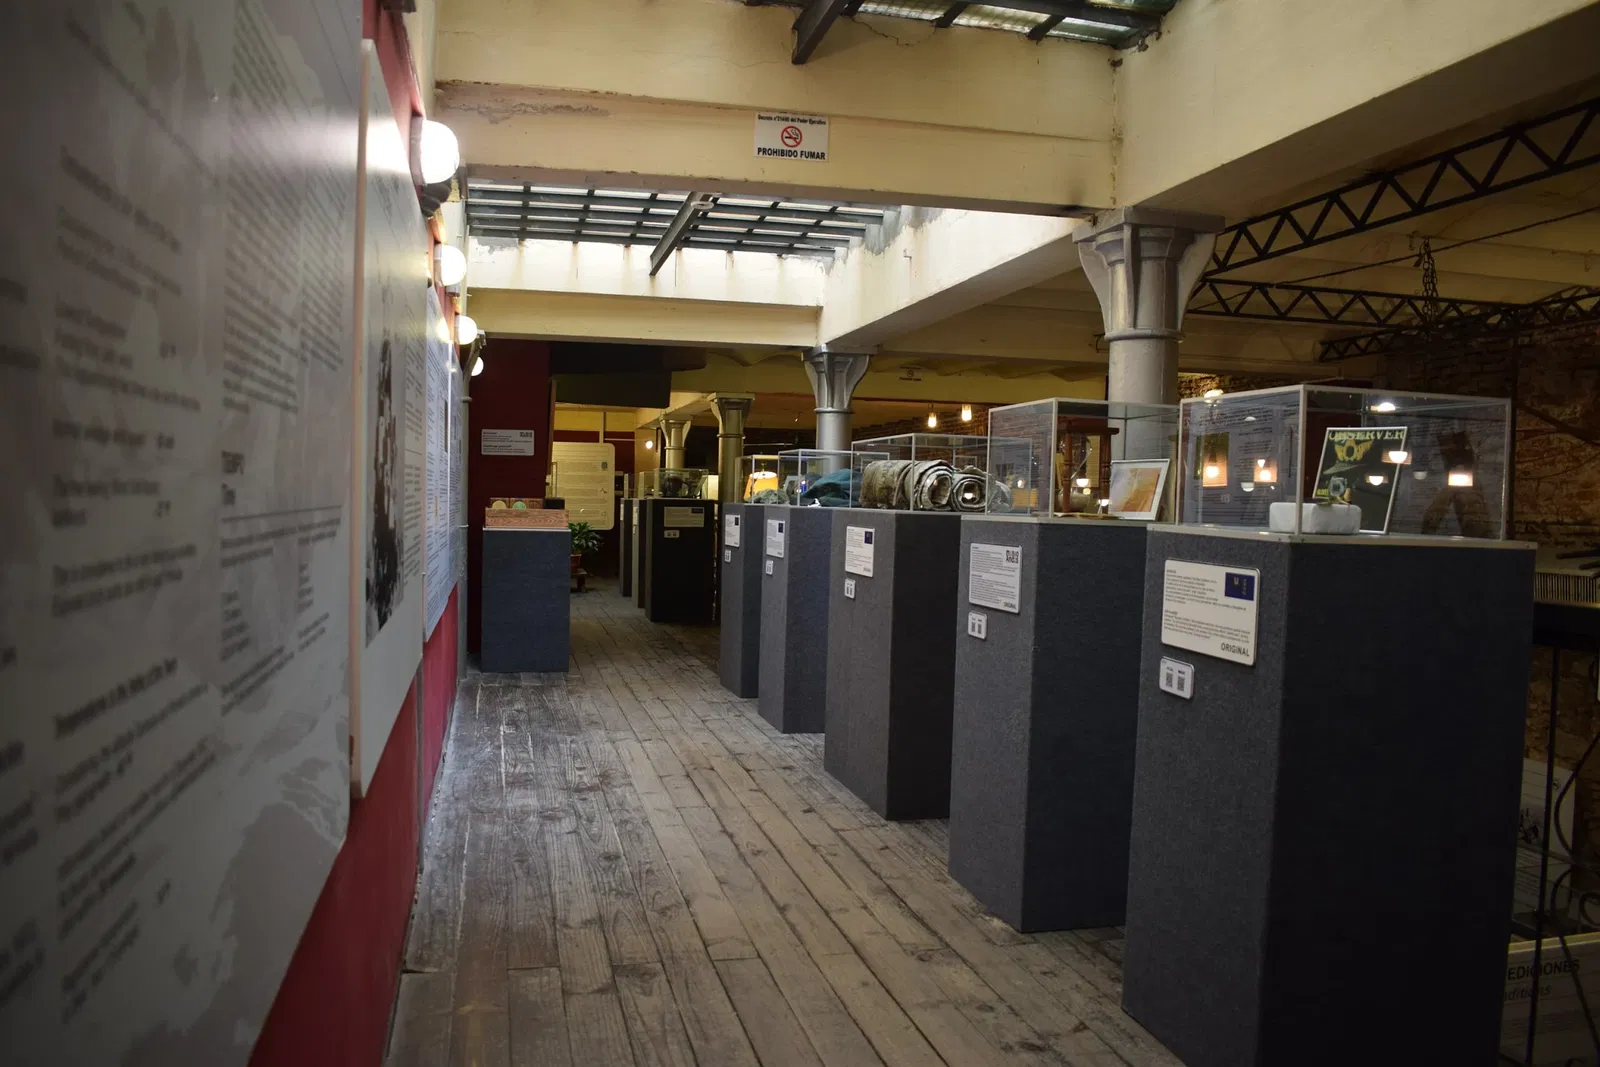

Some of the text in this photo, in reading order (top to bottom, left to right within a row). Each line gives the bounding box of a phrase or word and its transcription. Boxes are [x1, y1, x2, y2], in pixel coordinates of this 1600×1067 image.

[757, 147, 826, 160] PROHIBIDO FUMAR
[1329, 429, 1405, 441] OBSERVER
[1220, 642, 1250, 657] ORIGINAL
